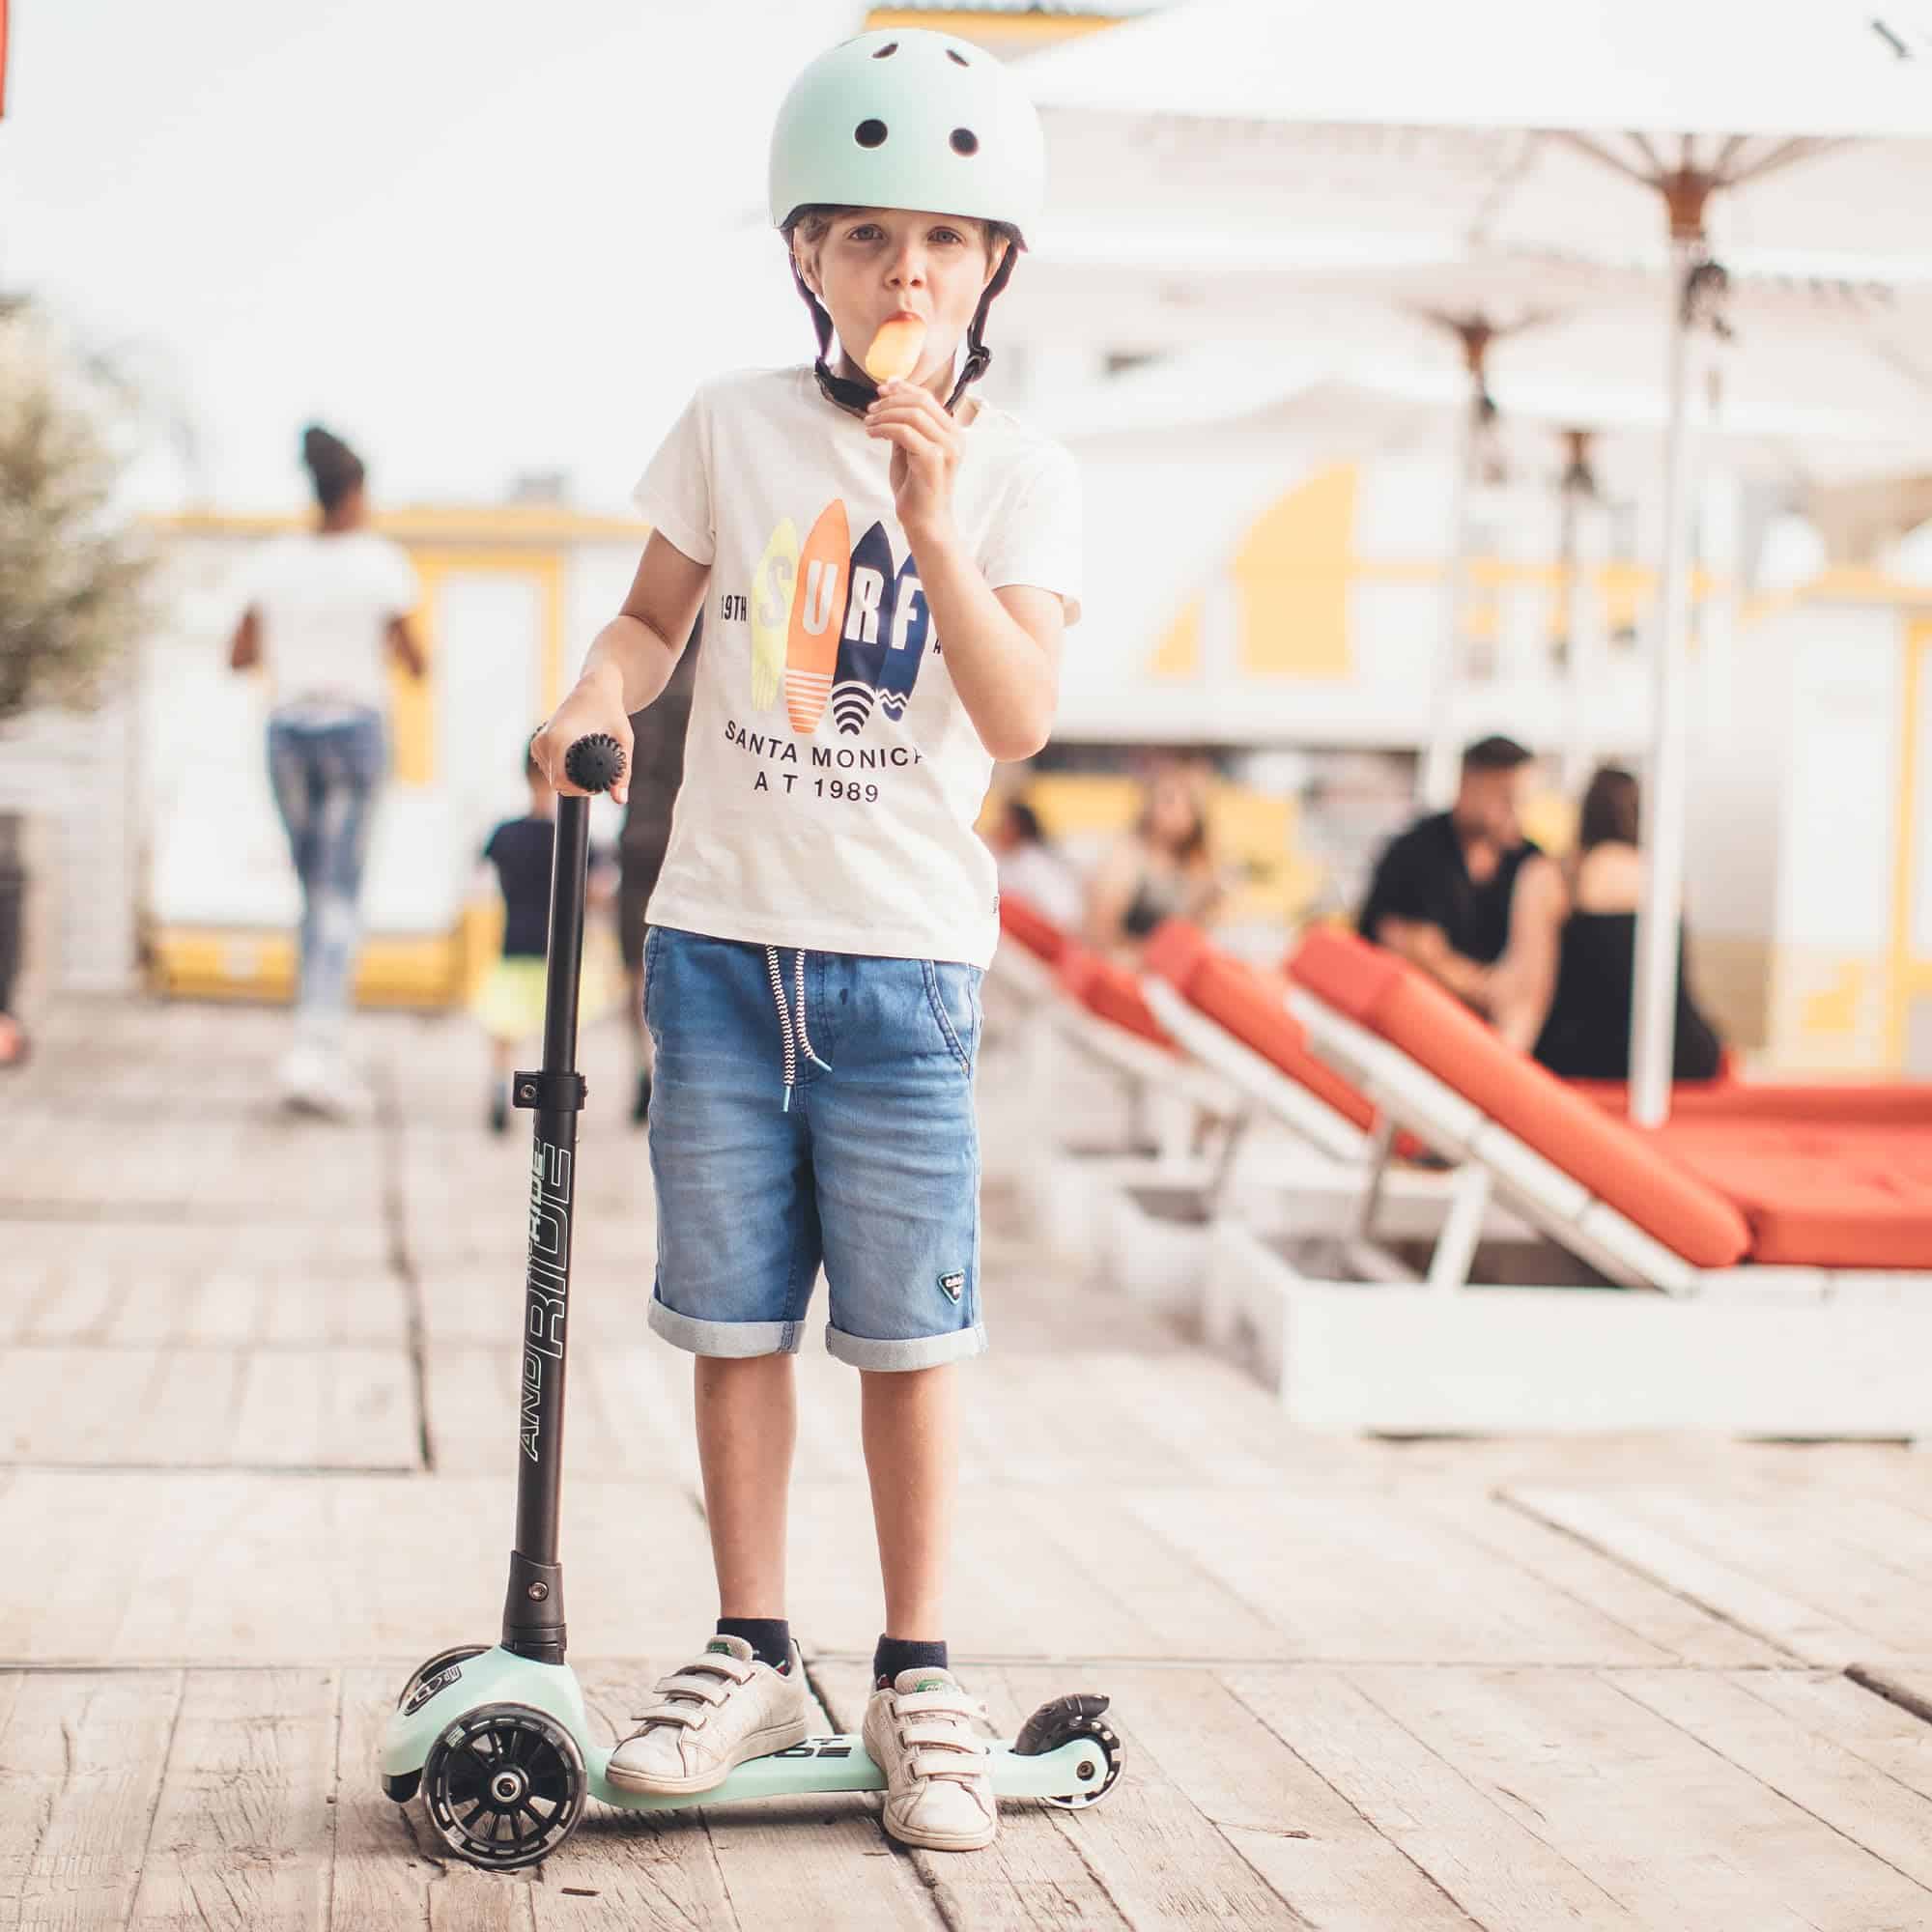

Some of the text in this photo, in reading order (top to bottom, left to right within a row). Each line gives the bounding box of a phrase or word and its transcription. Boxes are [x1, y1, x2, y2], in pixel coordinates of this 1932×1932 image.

[721, 594, 747, 622] 19TH
[757, 554, 924, 650] SURF
[724, 720, 797, 763] SANTA
[814, 779, 878, 803] 1989
